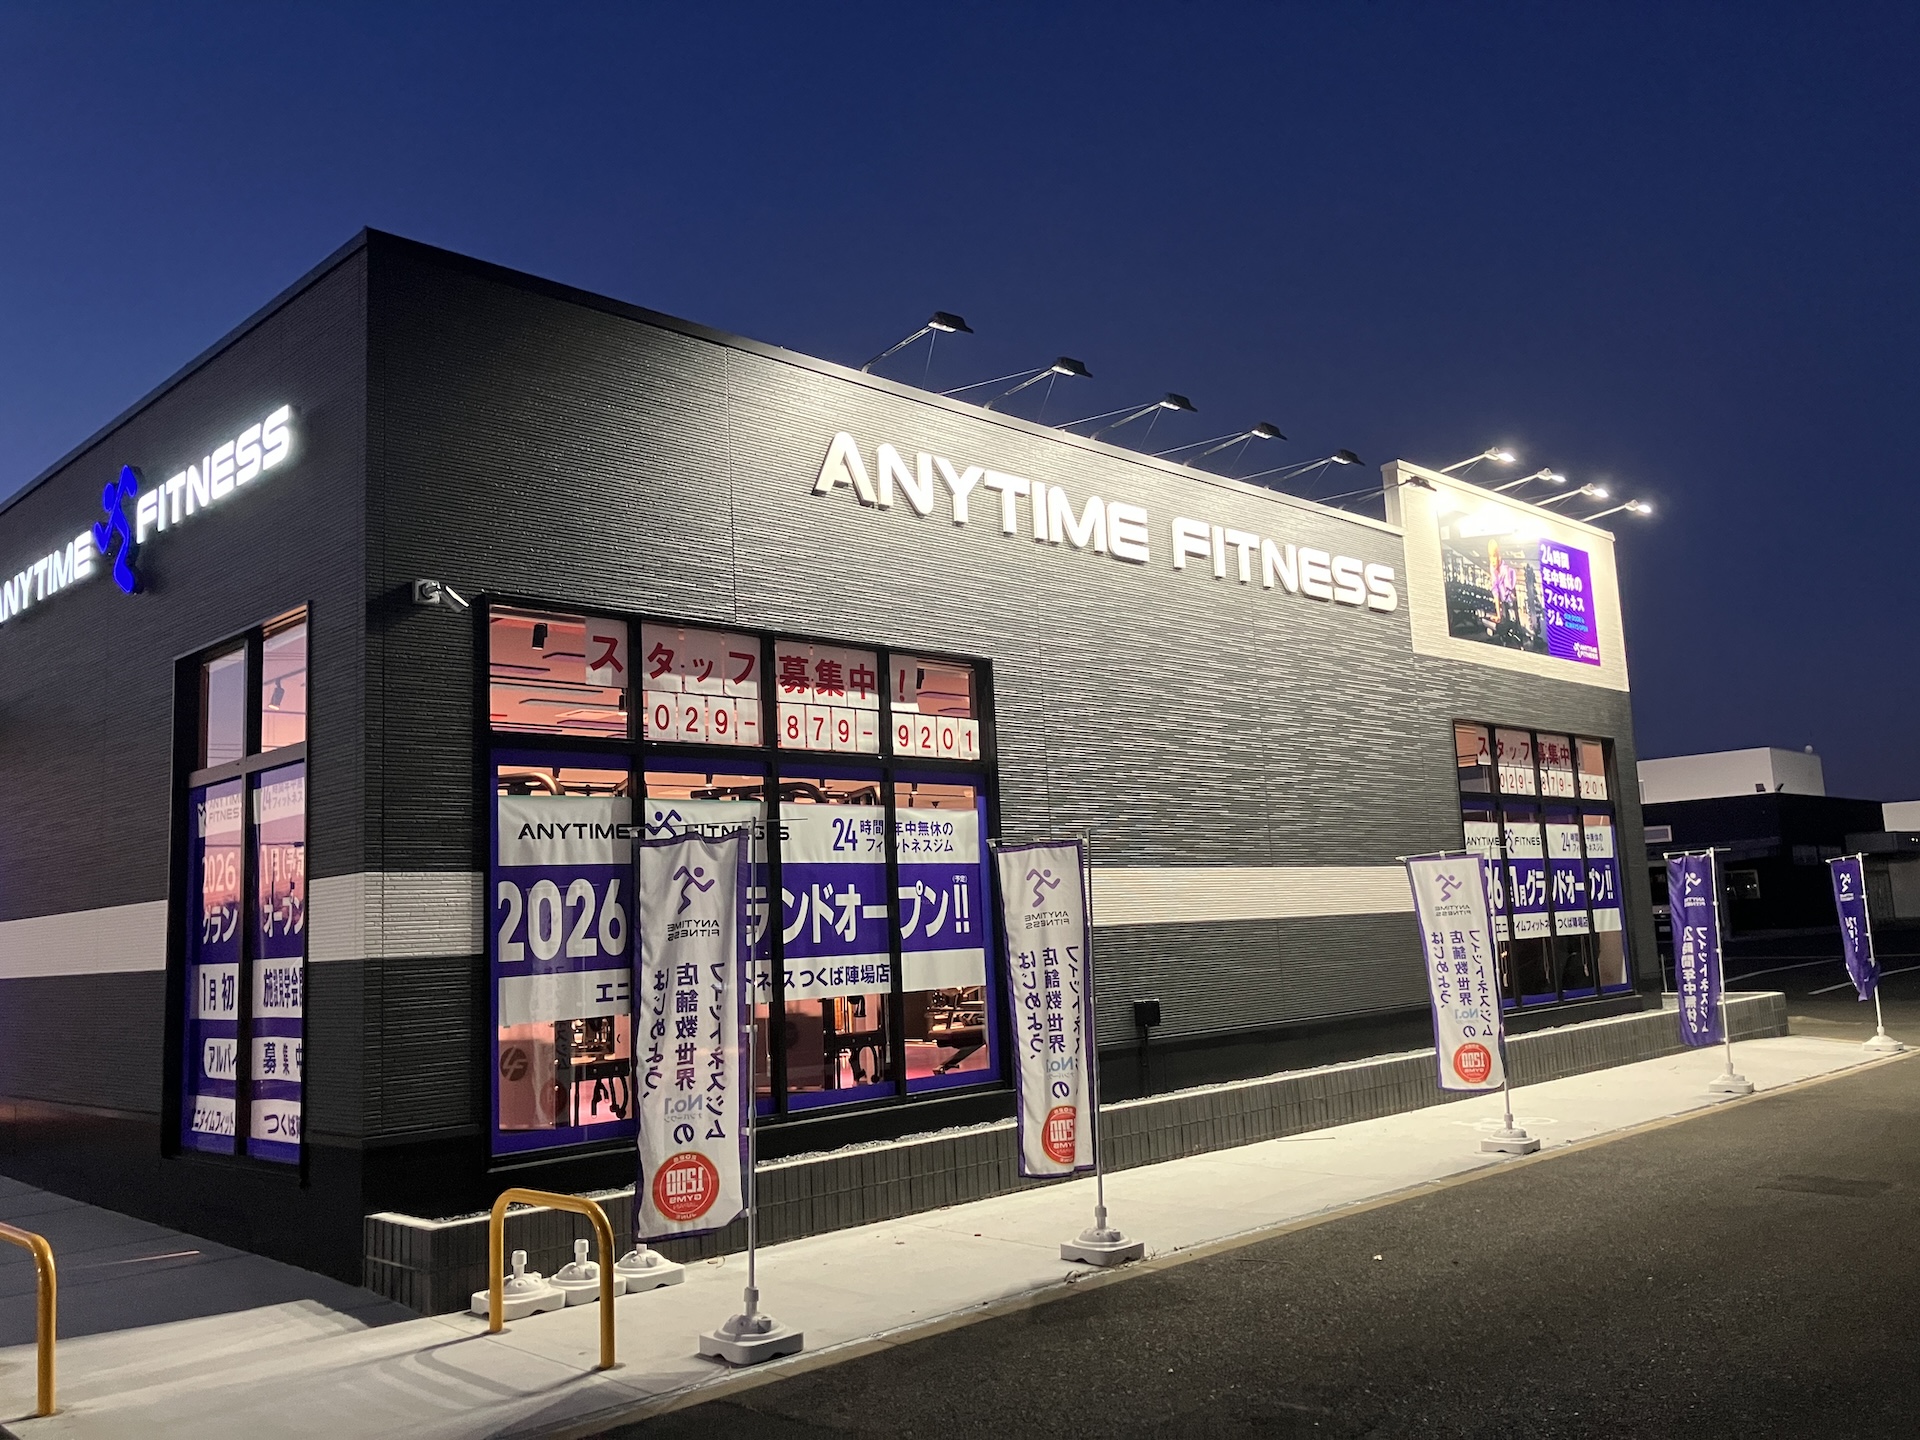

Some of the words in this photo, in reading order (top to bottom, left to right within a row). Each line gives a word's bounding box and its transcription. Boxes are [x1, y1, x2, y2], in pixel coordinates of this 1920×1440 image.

[136, 404, 290, 544] FITNESS
[813, 431, 1150, 564] ANYTIME
[1172, 516, 1398, 612] FITNESS
[1545, 588, 1585, 612] フィットネス
[1547, 609, 1563, 626] ジム
[654, 701, 974, 752] 029-879-9201
[518, 823, 630, 839] ANYTIME
[832, 818, 858, 851] 24
[1466, 836, 1500, 846] ANYTIME
[498, 878, 627, 962] 2026
